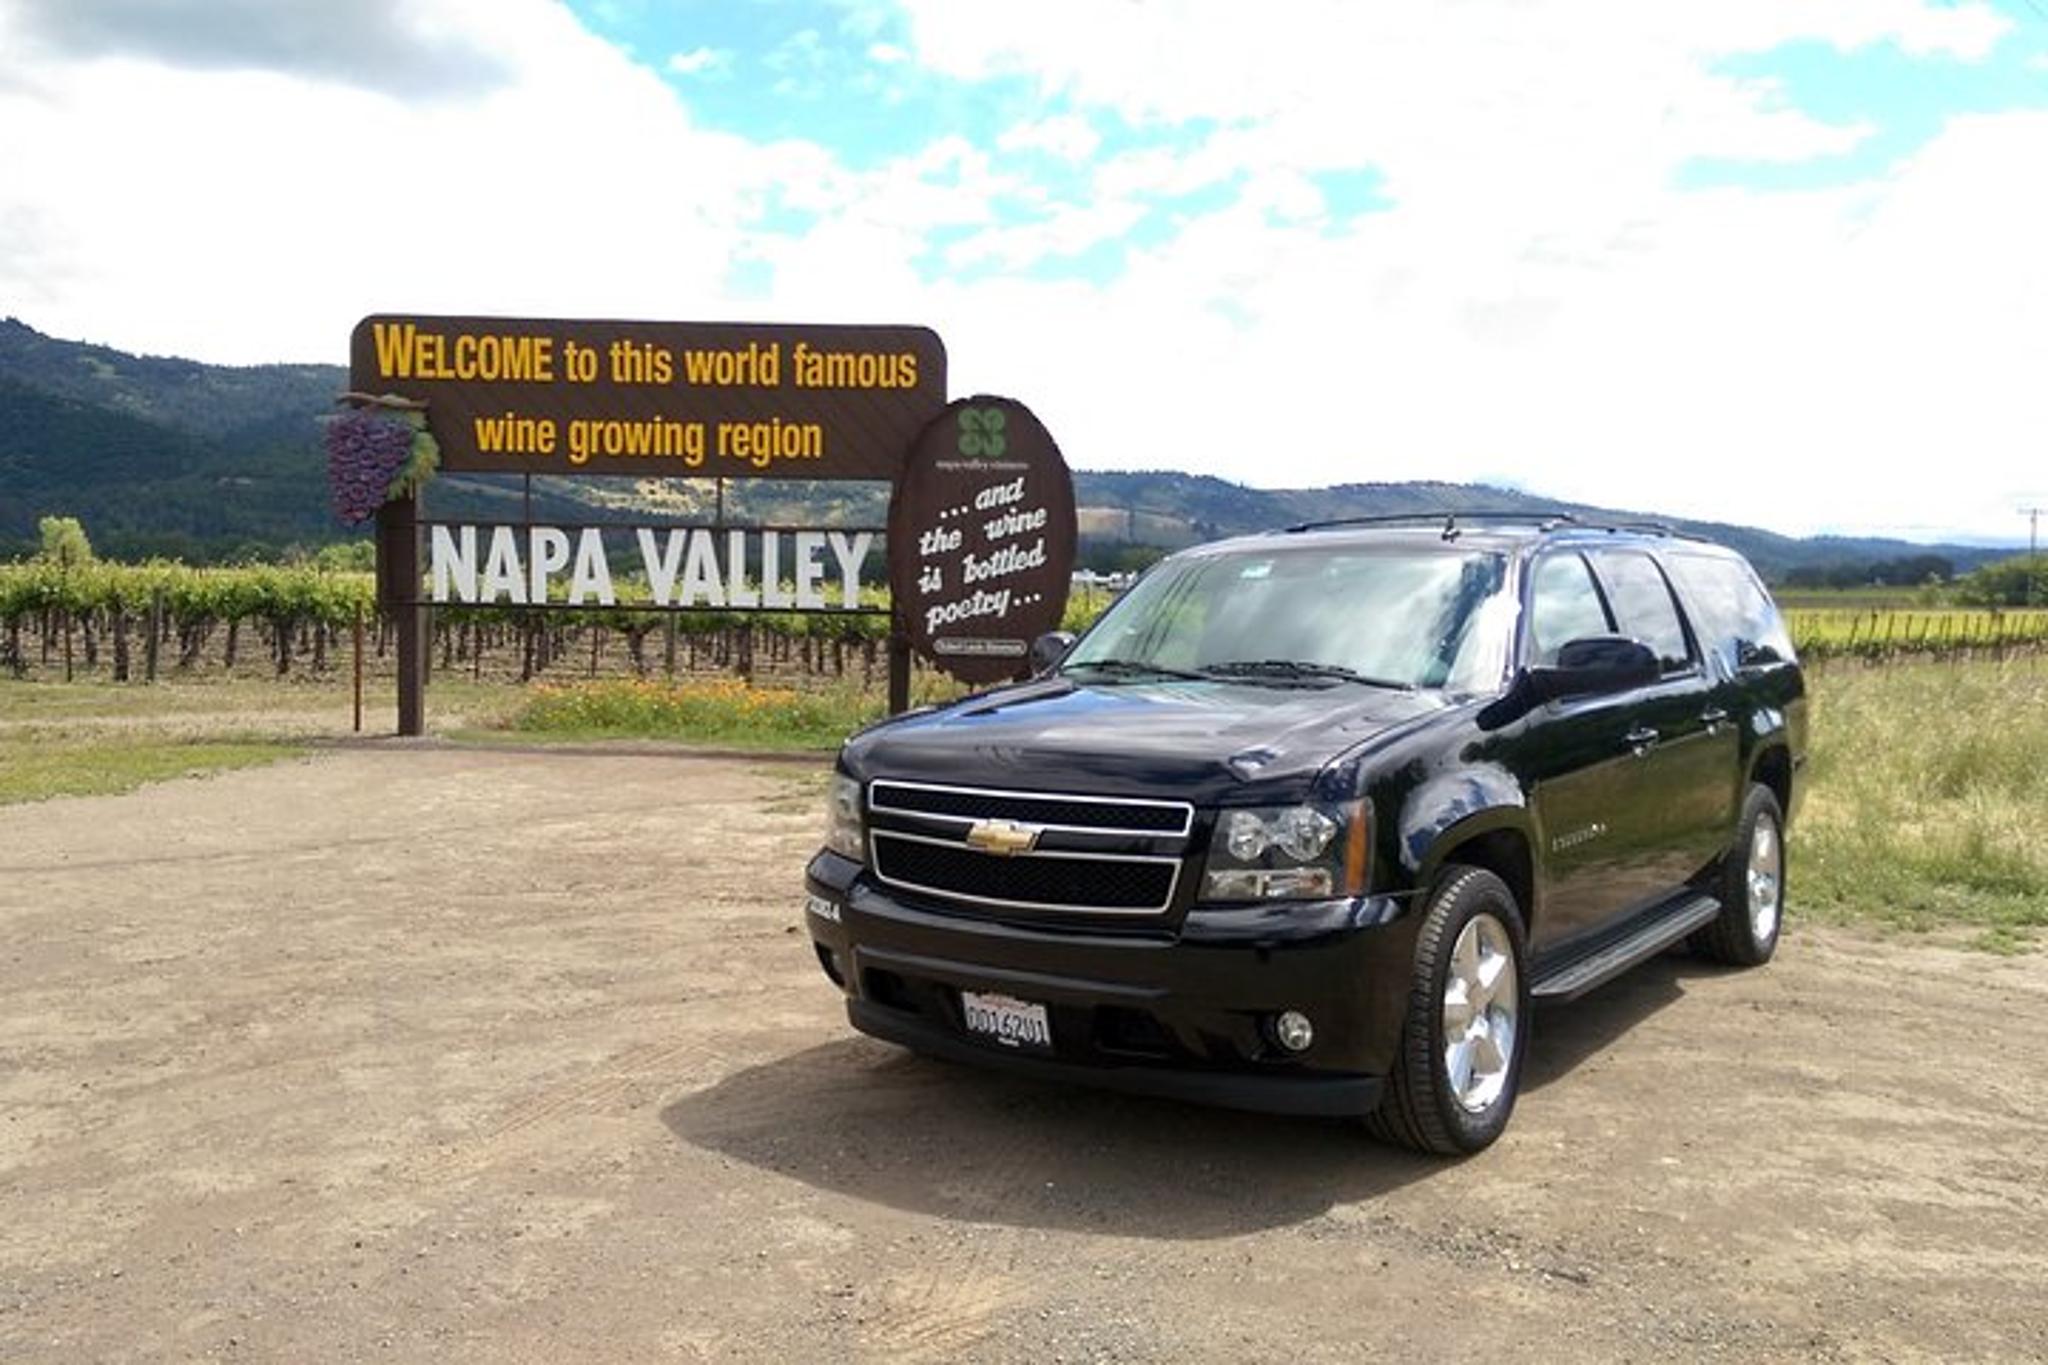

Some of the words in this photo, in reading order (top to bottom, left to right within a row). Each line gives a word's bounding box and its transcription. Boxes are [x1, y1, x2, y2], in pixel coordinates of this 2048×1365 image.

[374, 323, 553, 381] WELCOME
[564, 341, 598, 382] to
[609, 341, 673, 384] this
[685, 343, 780, 386] world
[793, 343, 917, 388] famous
[475, 413, 556, 454] wine
[568, 416, 704, 466] growing
[718, 418, 822, 465] region
[918, 526, 962, 556] the
[983, 507, 1047, 541] wine
[431, 525, 616, 605] NAPA
[636, 528, 874, 610] VALLEY
[917, 566, 943, 594] is
[962, 538, 1047, 584] bottled
